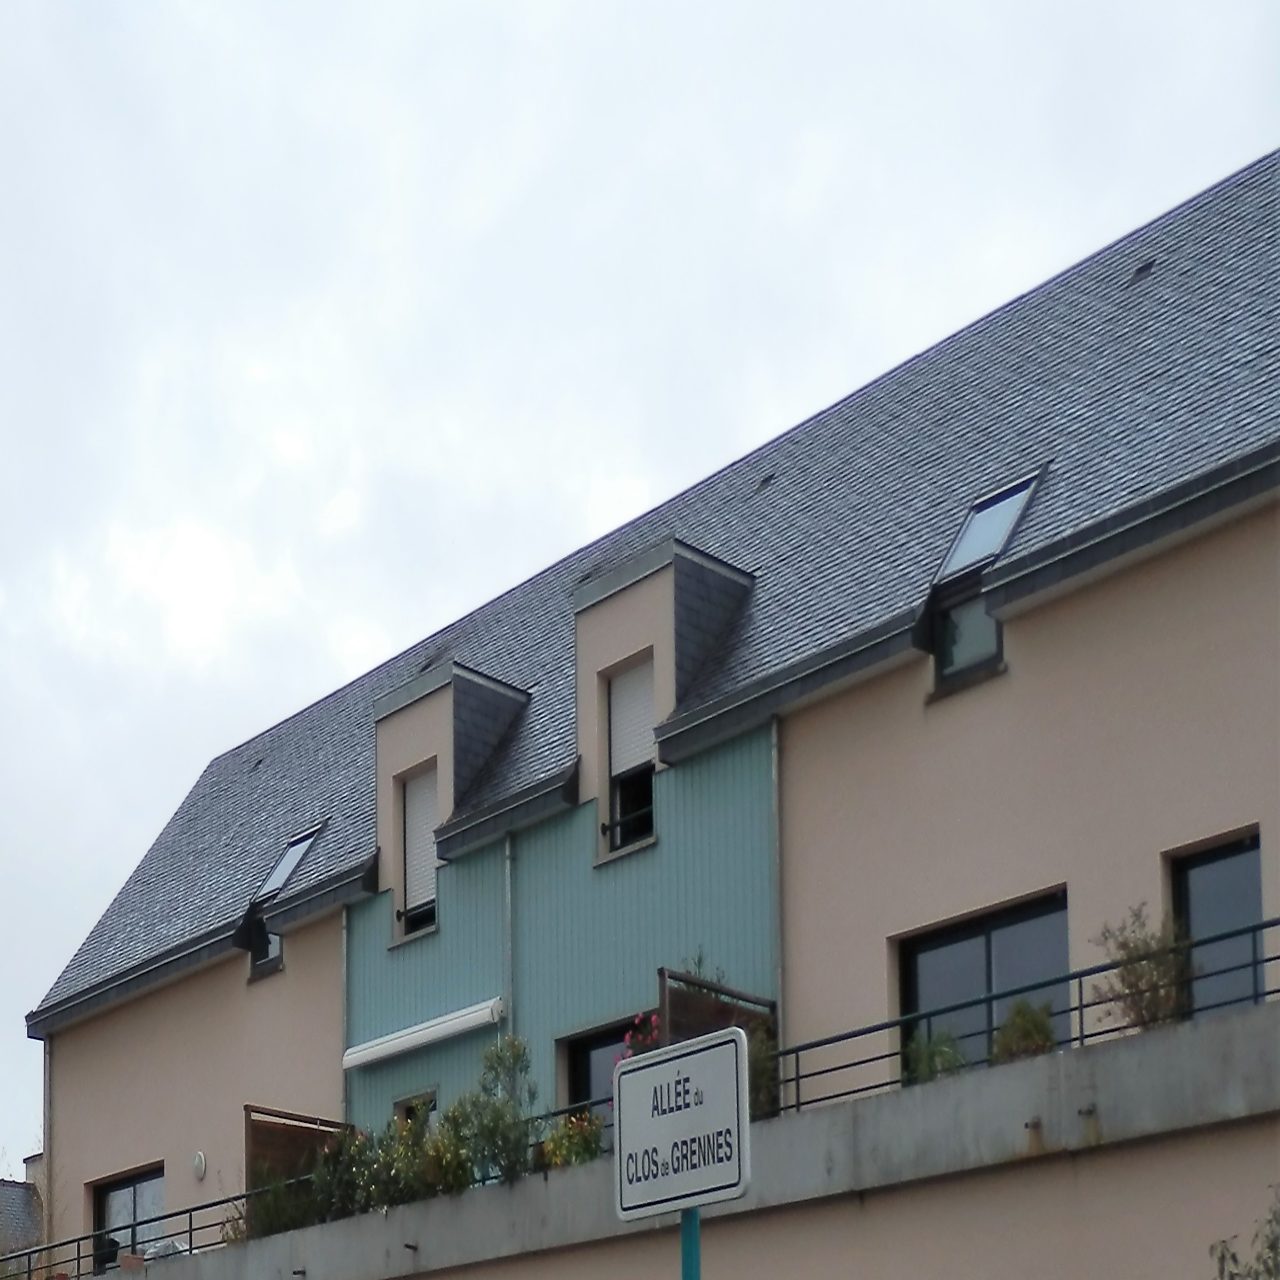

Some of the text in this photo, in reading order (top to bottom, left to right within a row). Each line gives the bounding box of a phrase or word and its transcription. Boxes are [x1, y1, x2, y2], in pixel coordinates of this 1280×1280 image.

[651, 1070, 704, 1118] ALLÉE du
[626, 1128, 733, 1185] CLOS de GRENNES
